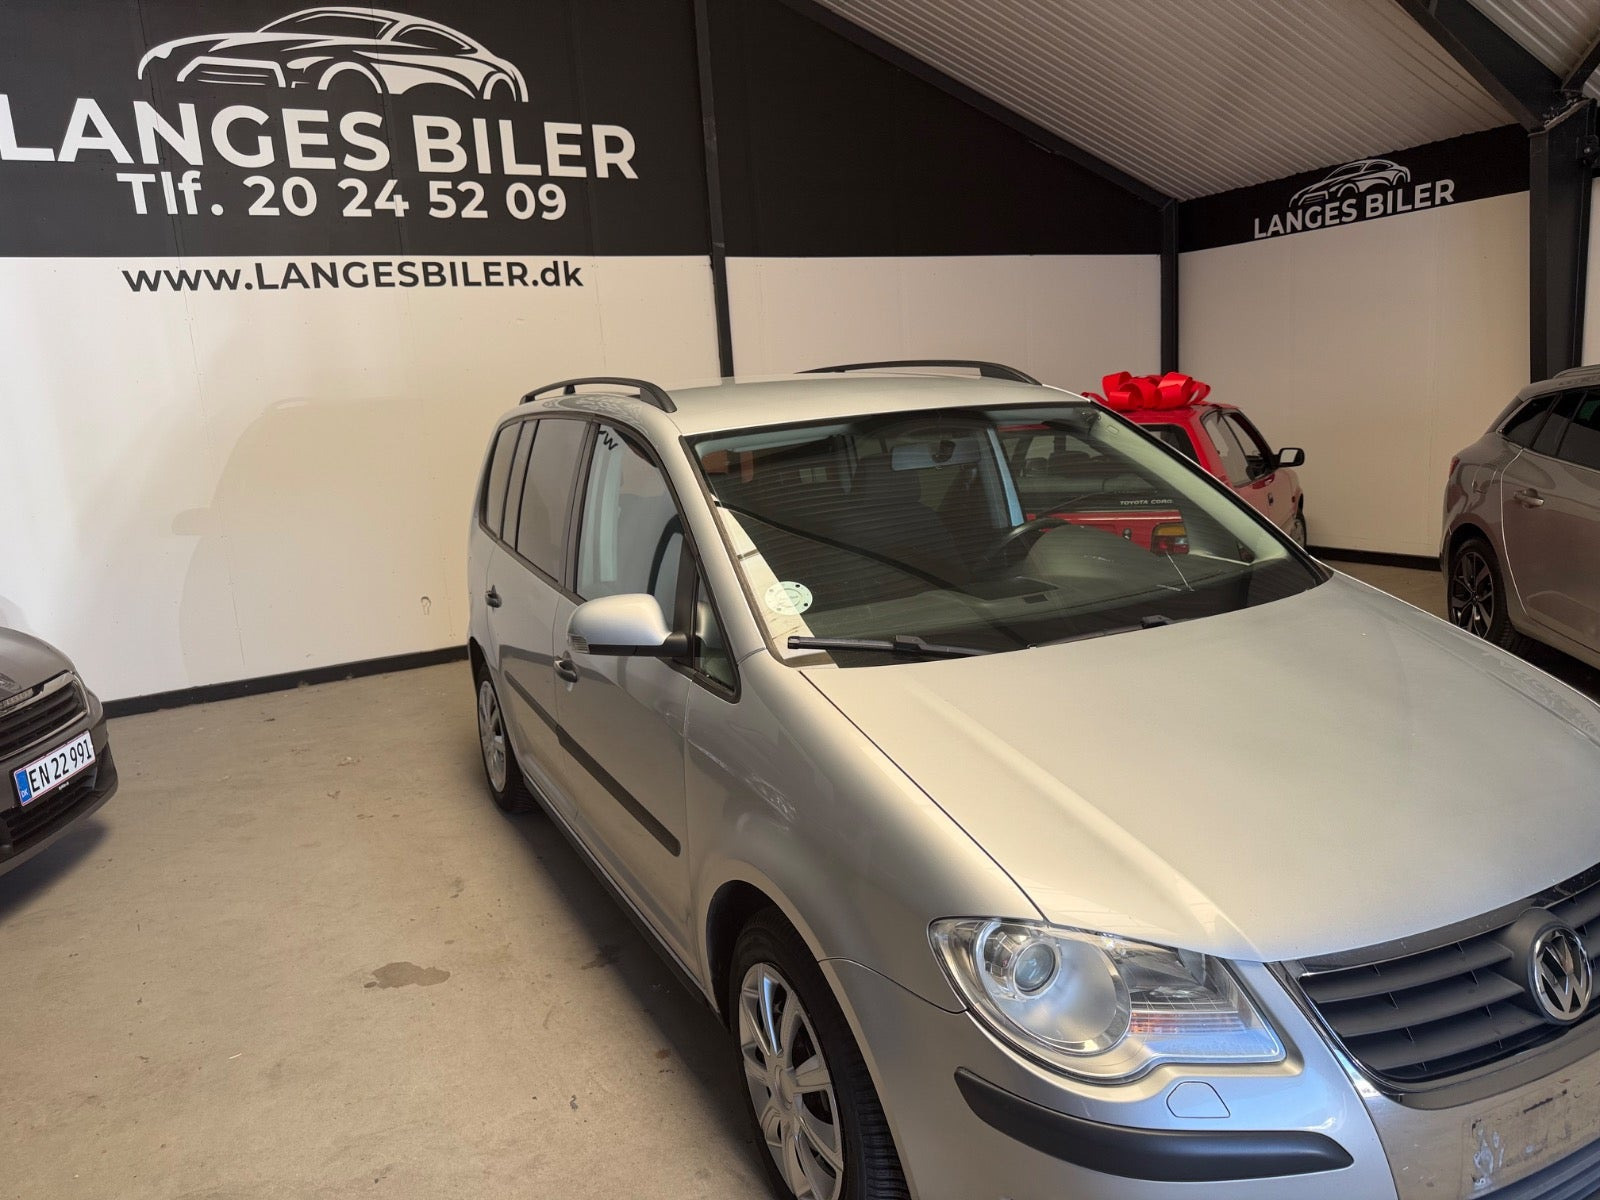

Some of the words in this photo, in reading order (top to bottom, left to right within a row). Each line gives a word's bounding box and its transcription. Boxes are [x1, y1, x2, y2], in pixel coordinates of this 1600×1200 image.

[0, 93, 391, 171] LANGES
[413, 114, 639, 179] BILER
[116, 170, 224, 216] Tlf.
[242, 176, 318, 217] 20
[338, 178, 410, 218] 24
[429, 181, 489, 219] 52
[506, 183, 567, 220] 09
[1254, 198, 1358, 240] LANGES
[1366, 179, 1455, 218] BILER
[122, 260, 584, 292] www.LANGESBILER.dk
[28, 762, 50, 792] EN
[50, 752, 69, 779] 22
[69, 739, 92, 768] 991
